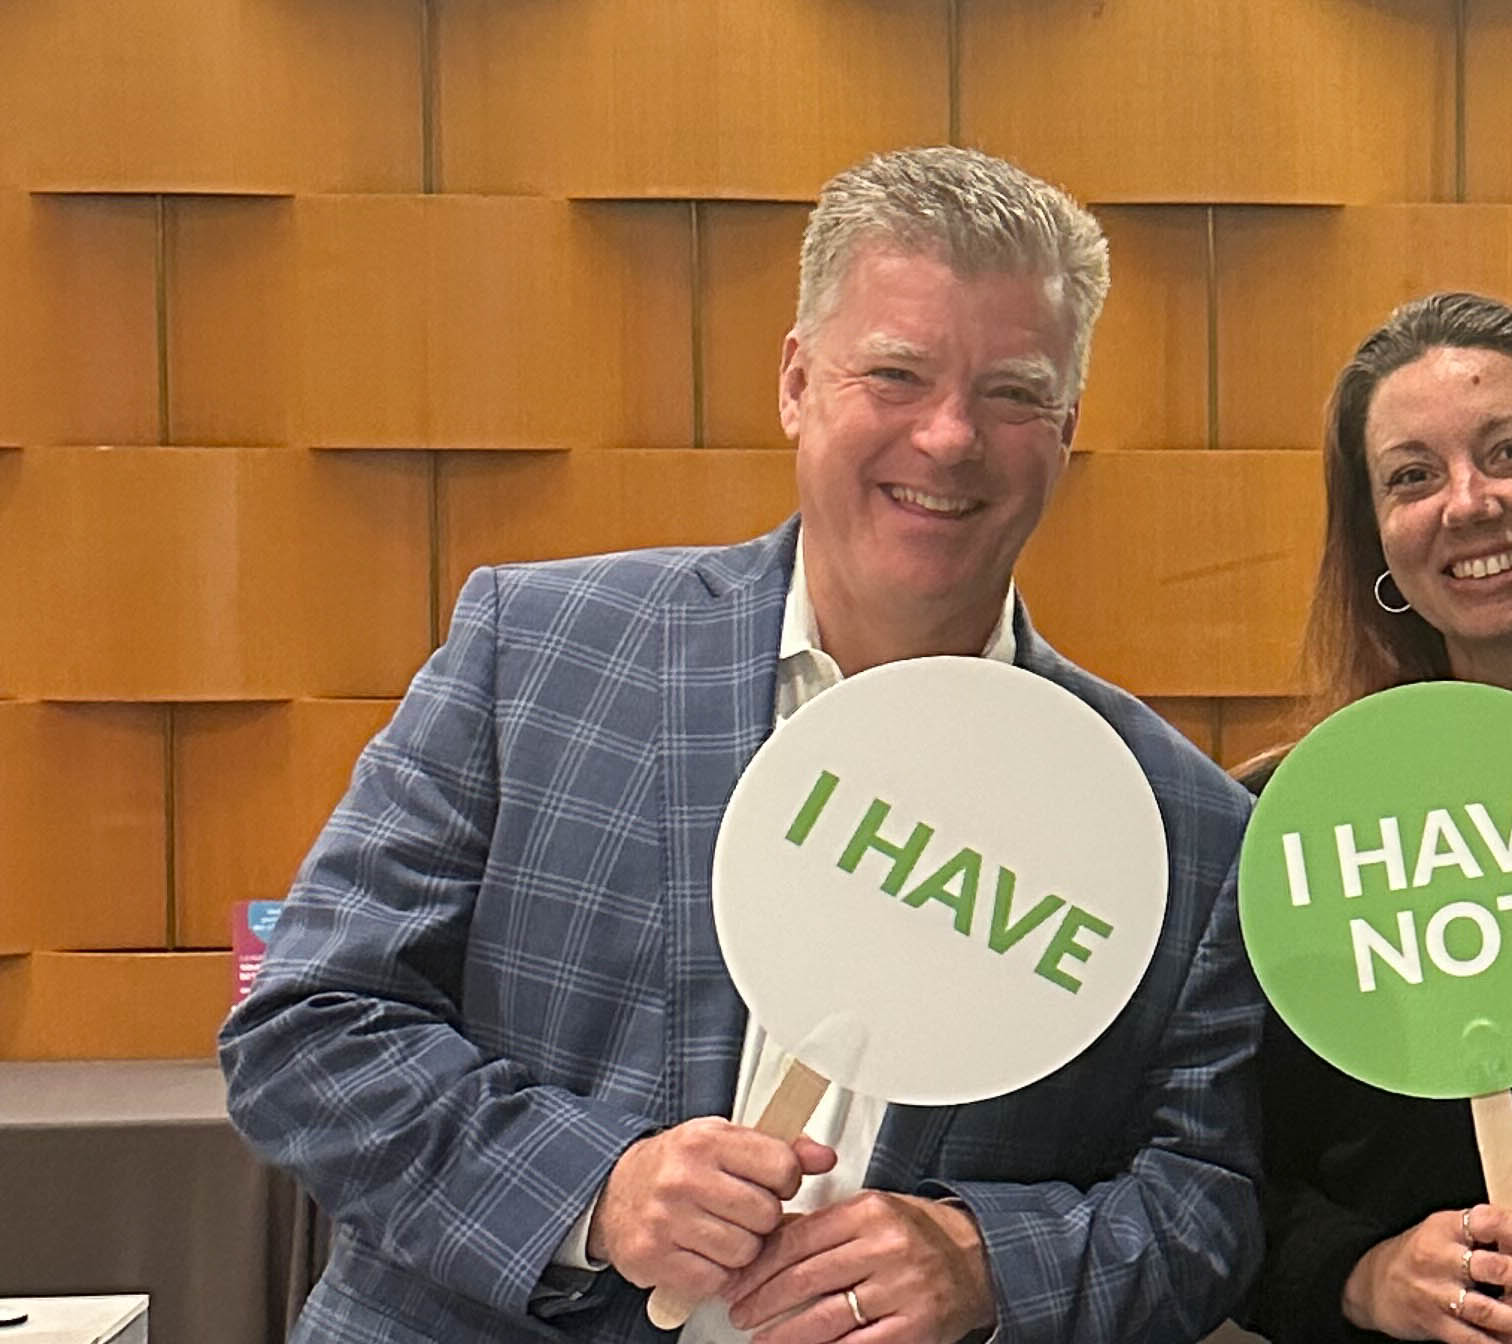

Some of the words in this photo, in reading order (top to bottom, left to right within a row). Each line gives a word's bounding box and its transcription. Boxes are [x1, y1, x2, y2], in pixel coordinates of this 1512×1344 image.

[785, 770, 840, 846] I
[837, 798, 1114, 995] HAVE
[1282, 832, 1311, 906] I
